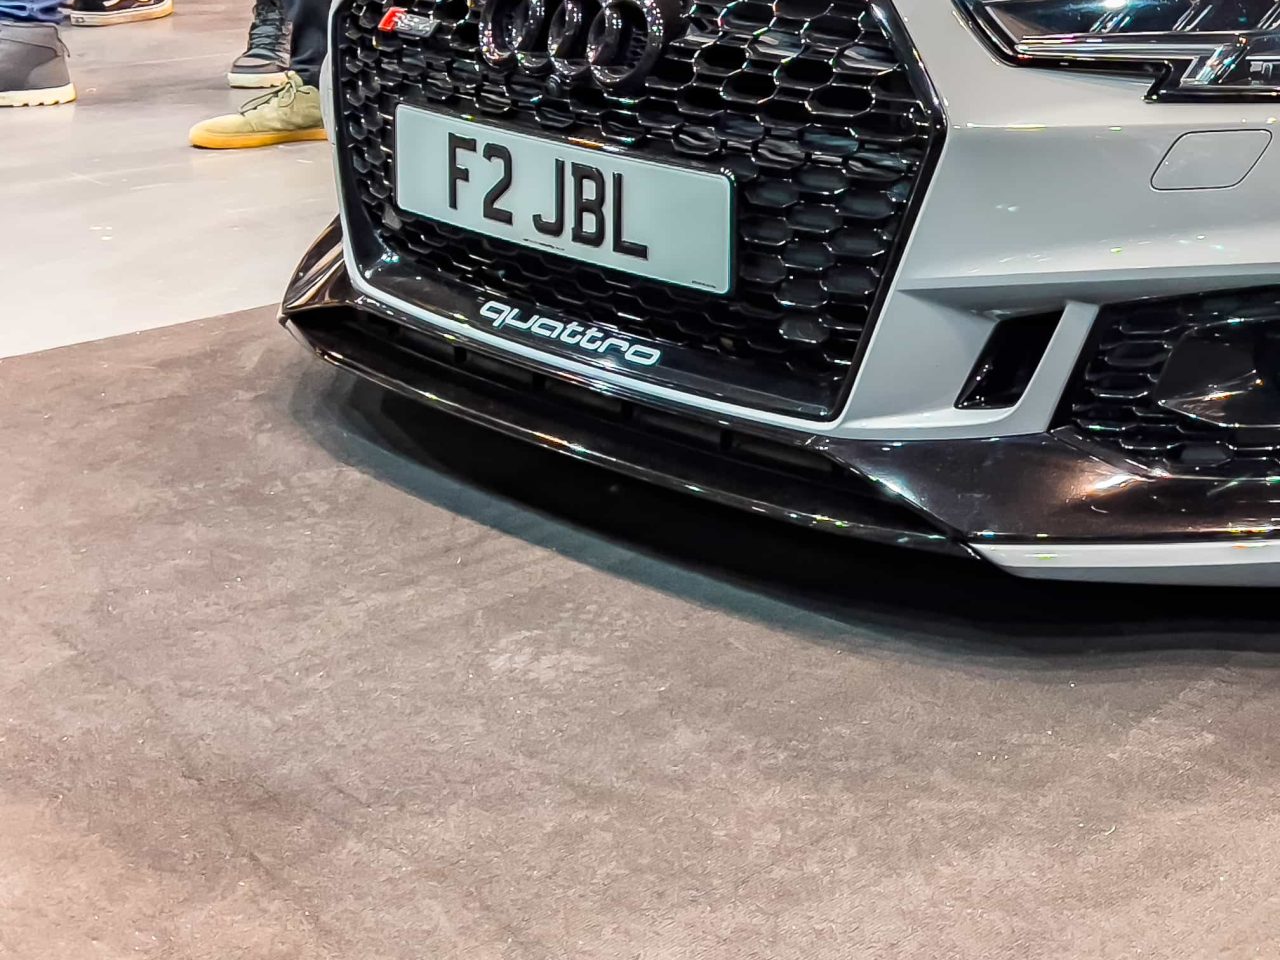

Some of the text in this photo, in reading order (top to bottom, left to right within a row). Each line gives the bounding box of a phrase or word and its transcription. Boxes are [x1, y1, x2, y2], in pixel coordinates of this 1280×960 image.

[448, 131, 648, 261] F2 JBL
[479, 300, 661, 366] quattro
